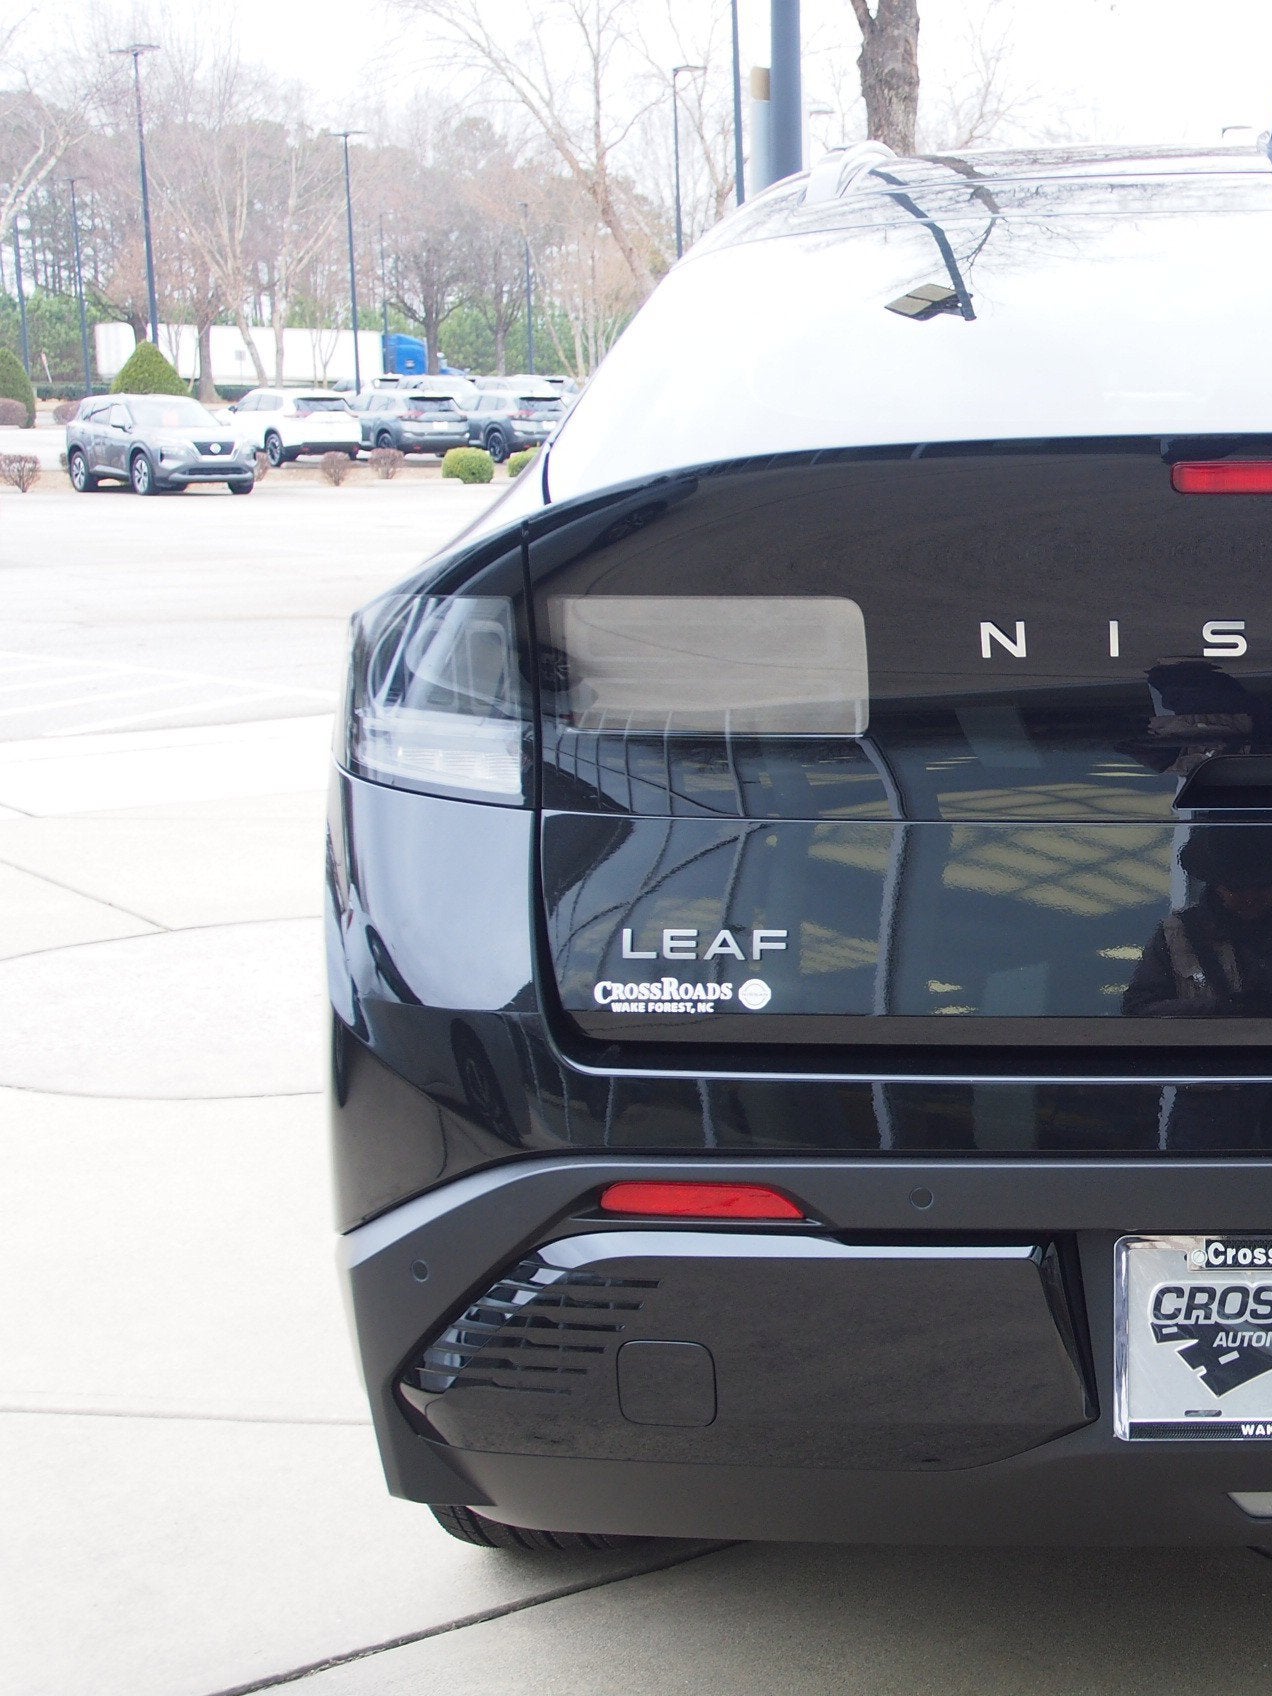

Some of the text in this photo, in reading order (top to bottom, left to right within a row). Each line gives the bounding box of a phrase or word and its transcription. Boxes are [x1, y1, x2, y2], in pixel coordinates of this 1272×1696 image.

[622, 928, 788, 961] LEAF
[611, 1002, 714, 1014] WAKE FOREST, NC
